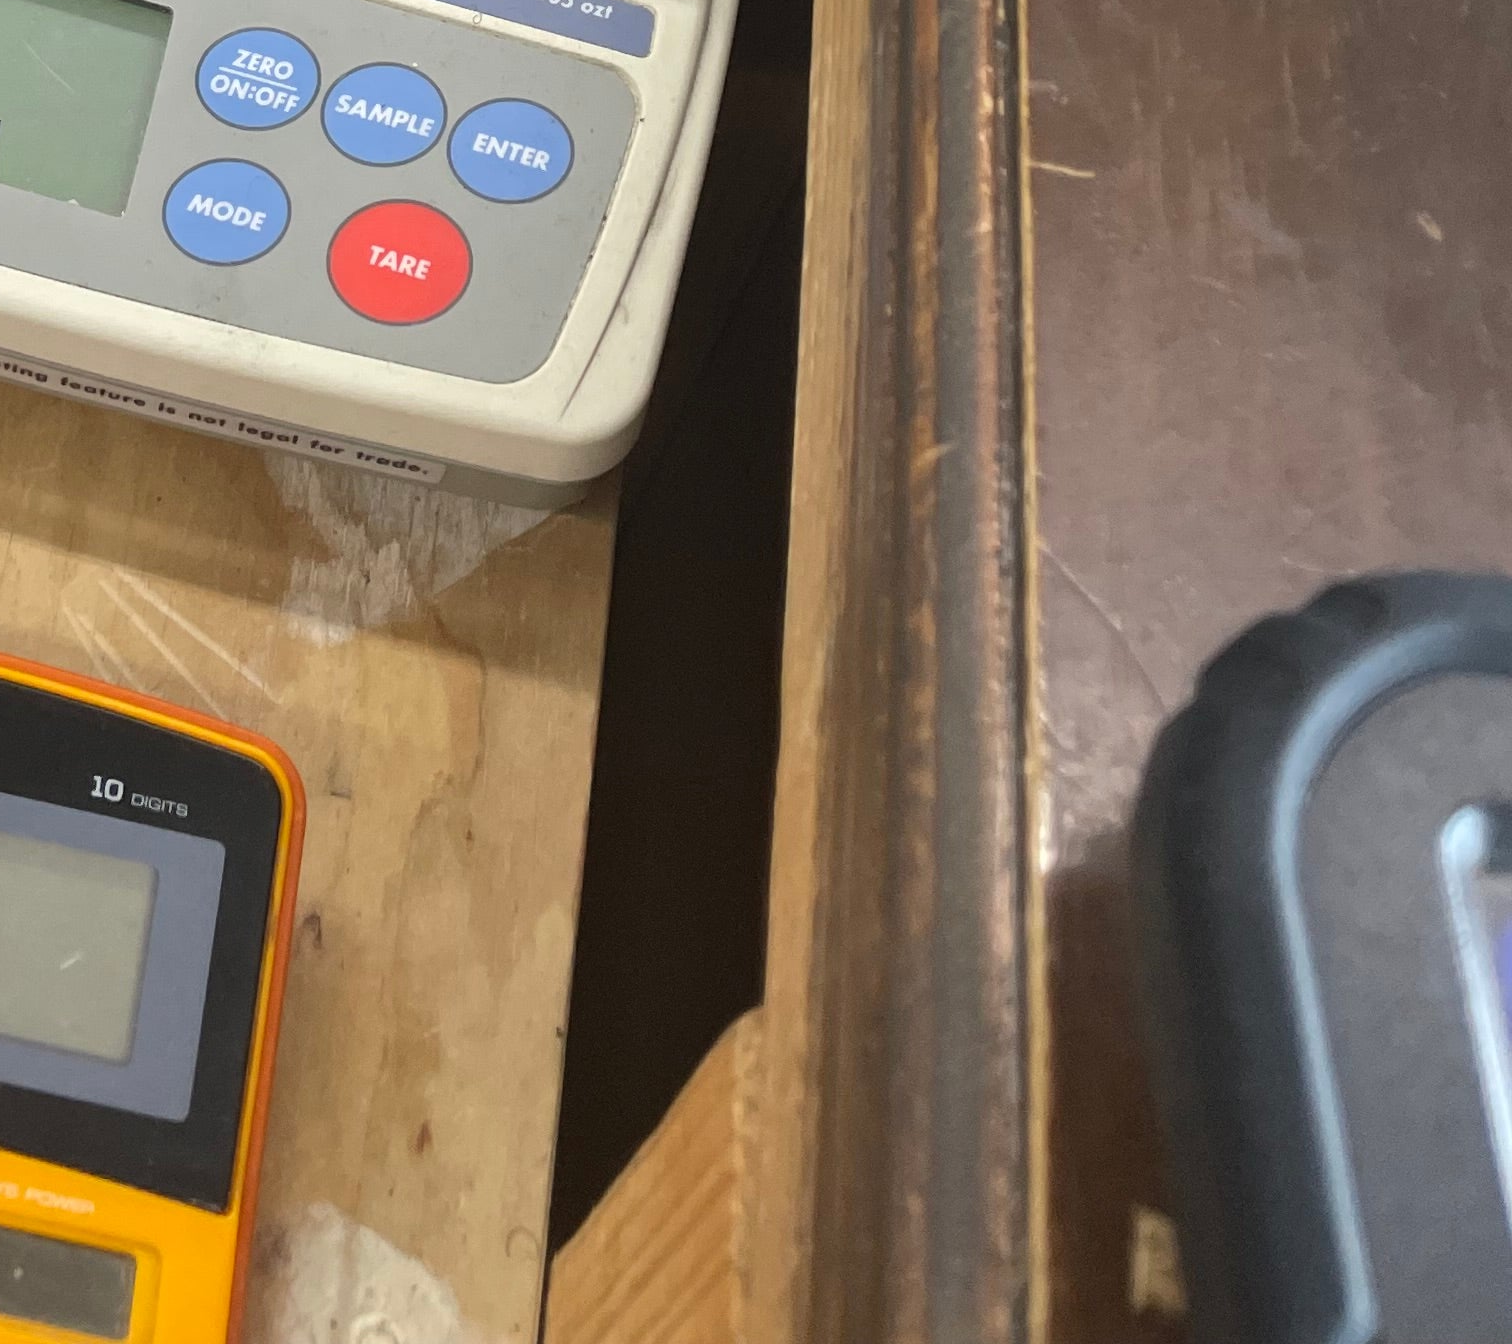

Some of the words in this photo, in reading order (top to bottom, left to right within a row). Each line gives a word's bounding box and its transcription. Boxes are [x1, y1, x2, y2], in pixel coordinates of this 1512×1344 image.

[580, 1, 614, 20] ozt
[231, 48, 294, 80] ZERO
[334, 94, 435, 138] SAMPLE
[472, 133, 551, 171] ENTER
[187, 193, 267, 232] MODE
[368, 245, 431, 280] TARE
[60, 376, 146, 407] feature
[158, 402, 176, 414] is
[188, 412, 226, 427] not
[238, 422, 298, 444] legal
[310, 440, 344, 454] for
[356, 451, 428, 475] trade.
[91, 775, 124, 802] 10
[130, 793, 188, 817] DIGITS
